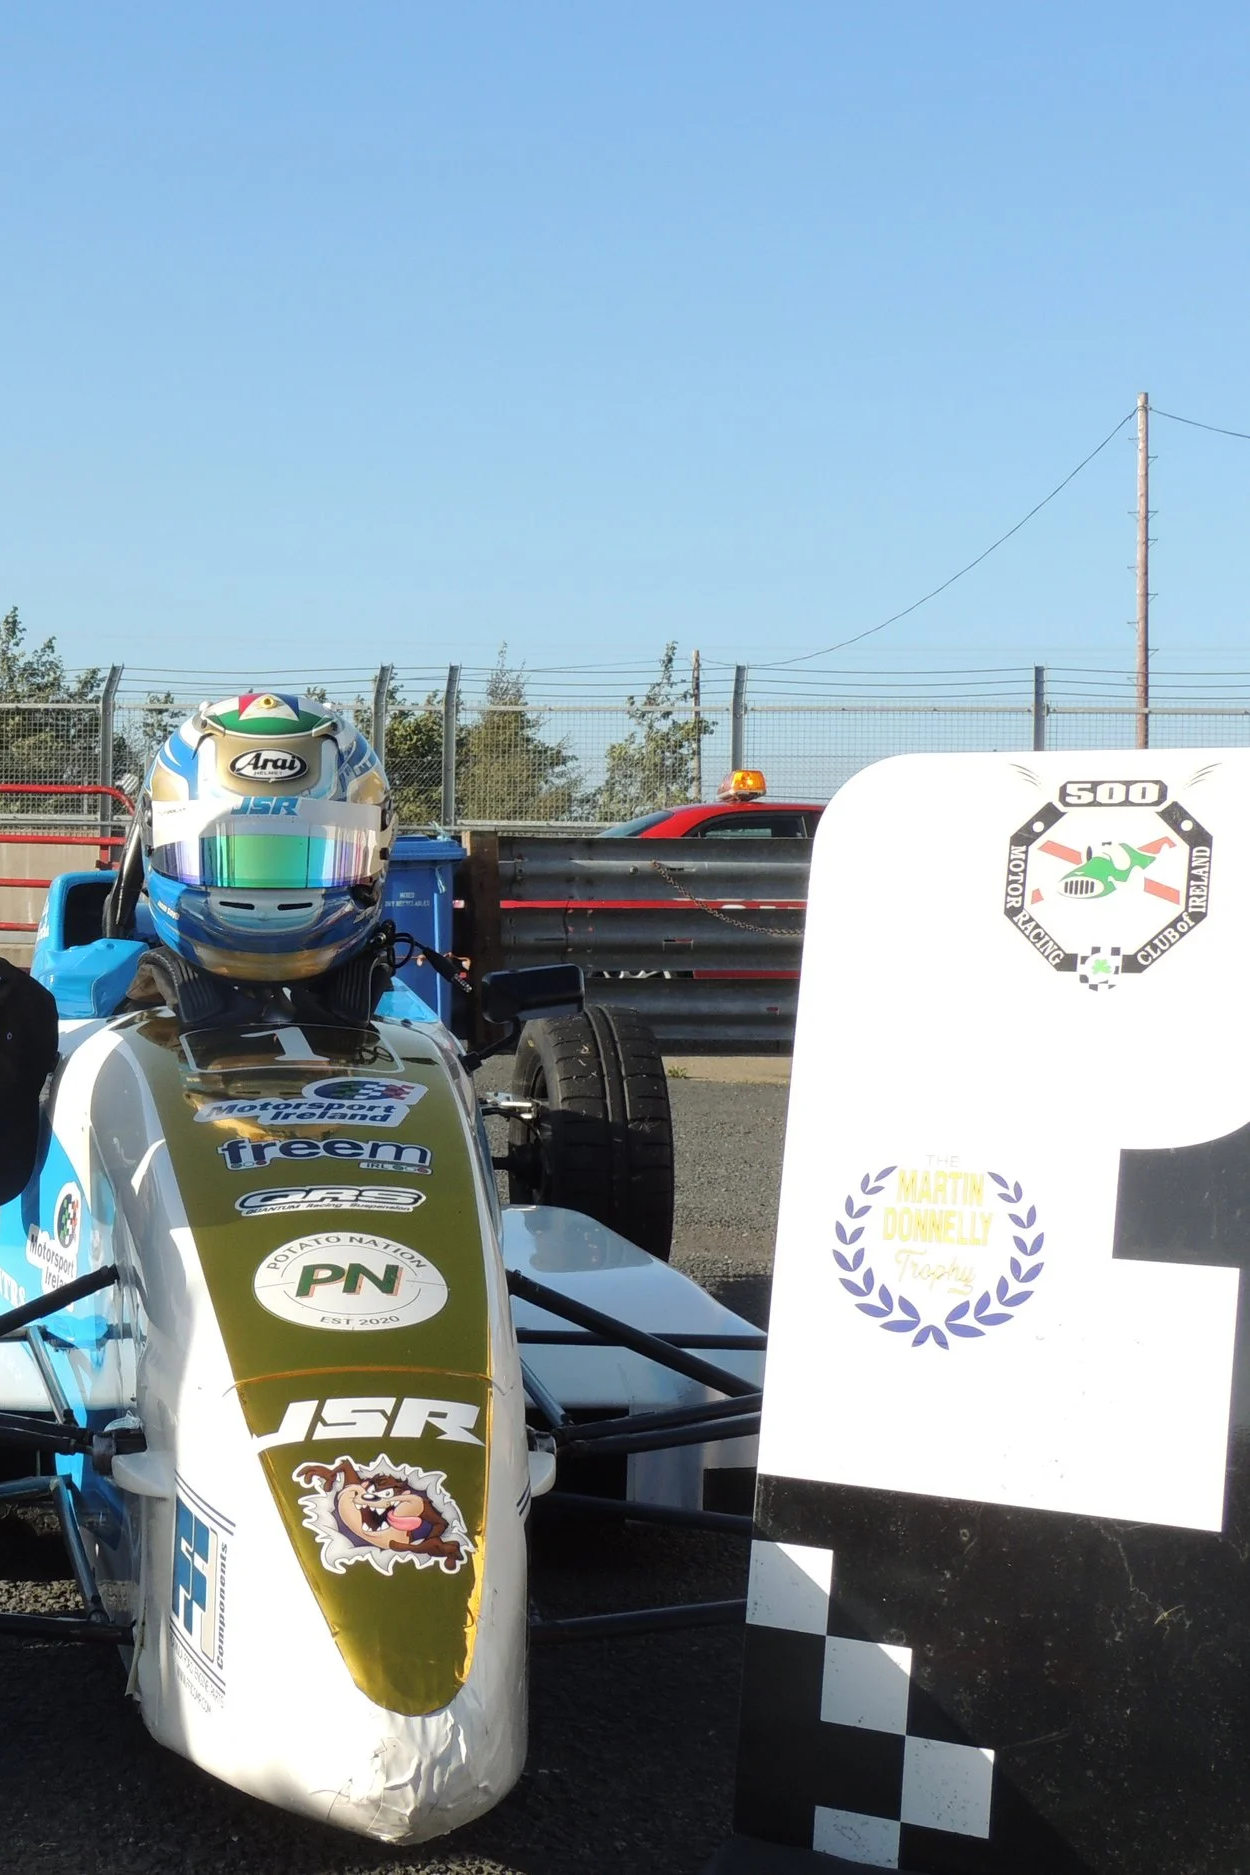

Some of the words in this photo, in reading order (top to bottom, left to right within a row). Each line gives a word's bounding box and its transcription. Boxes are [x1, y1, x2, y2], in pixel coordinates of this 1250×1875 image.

[250, 752, 298, 772] Arai
[230, 796, 300, 817] JSR
[1065, 782, 1160, 805] 500
[1006, 845, 1027, 909] MOTOR
[1189, 846, 1211, 914] IRELAND
[1013, 911, 1065, 966] RACING
[1177, 912, 1196, 933] of
[1136, 928, 1180, 966] CLUB
[241, 1026, 331, 1062] 1
[205, 1101, 398, 1119] Motorsport
[269, 1107, 395, 1123] Ireland
[220, 1139, 431, 1165] freem
[925, 1154, 960, 1168] THE
[239, 1187, 423, 1209] QRS
[897, 1168, 985, 1207] MARTIN
[246, 1204, 301, 1215] QUANTUM
[350, 1202, 411, 1211] Suspension
[883, 1206, 994, 1247] DONNELLY
[29, 1234, 75, 1279] Motorsport
[267, 1235, 341, 1270] POTATO
[349, 1236, 427, 1269] NATION
[44, 1266, 68, 1289] Irela
[295, 1262, 404, 1299] PN
[894, 1248, 977, 1296] Trophy
[320, 1316, 355, 1326] EST
[359, 1315, 400, 1327] 2020
[252, 1396, 486, 1454] JSR
[216, 1541, 228, 1671] Components
